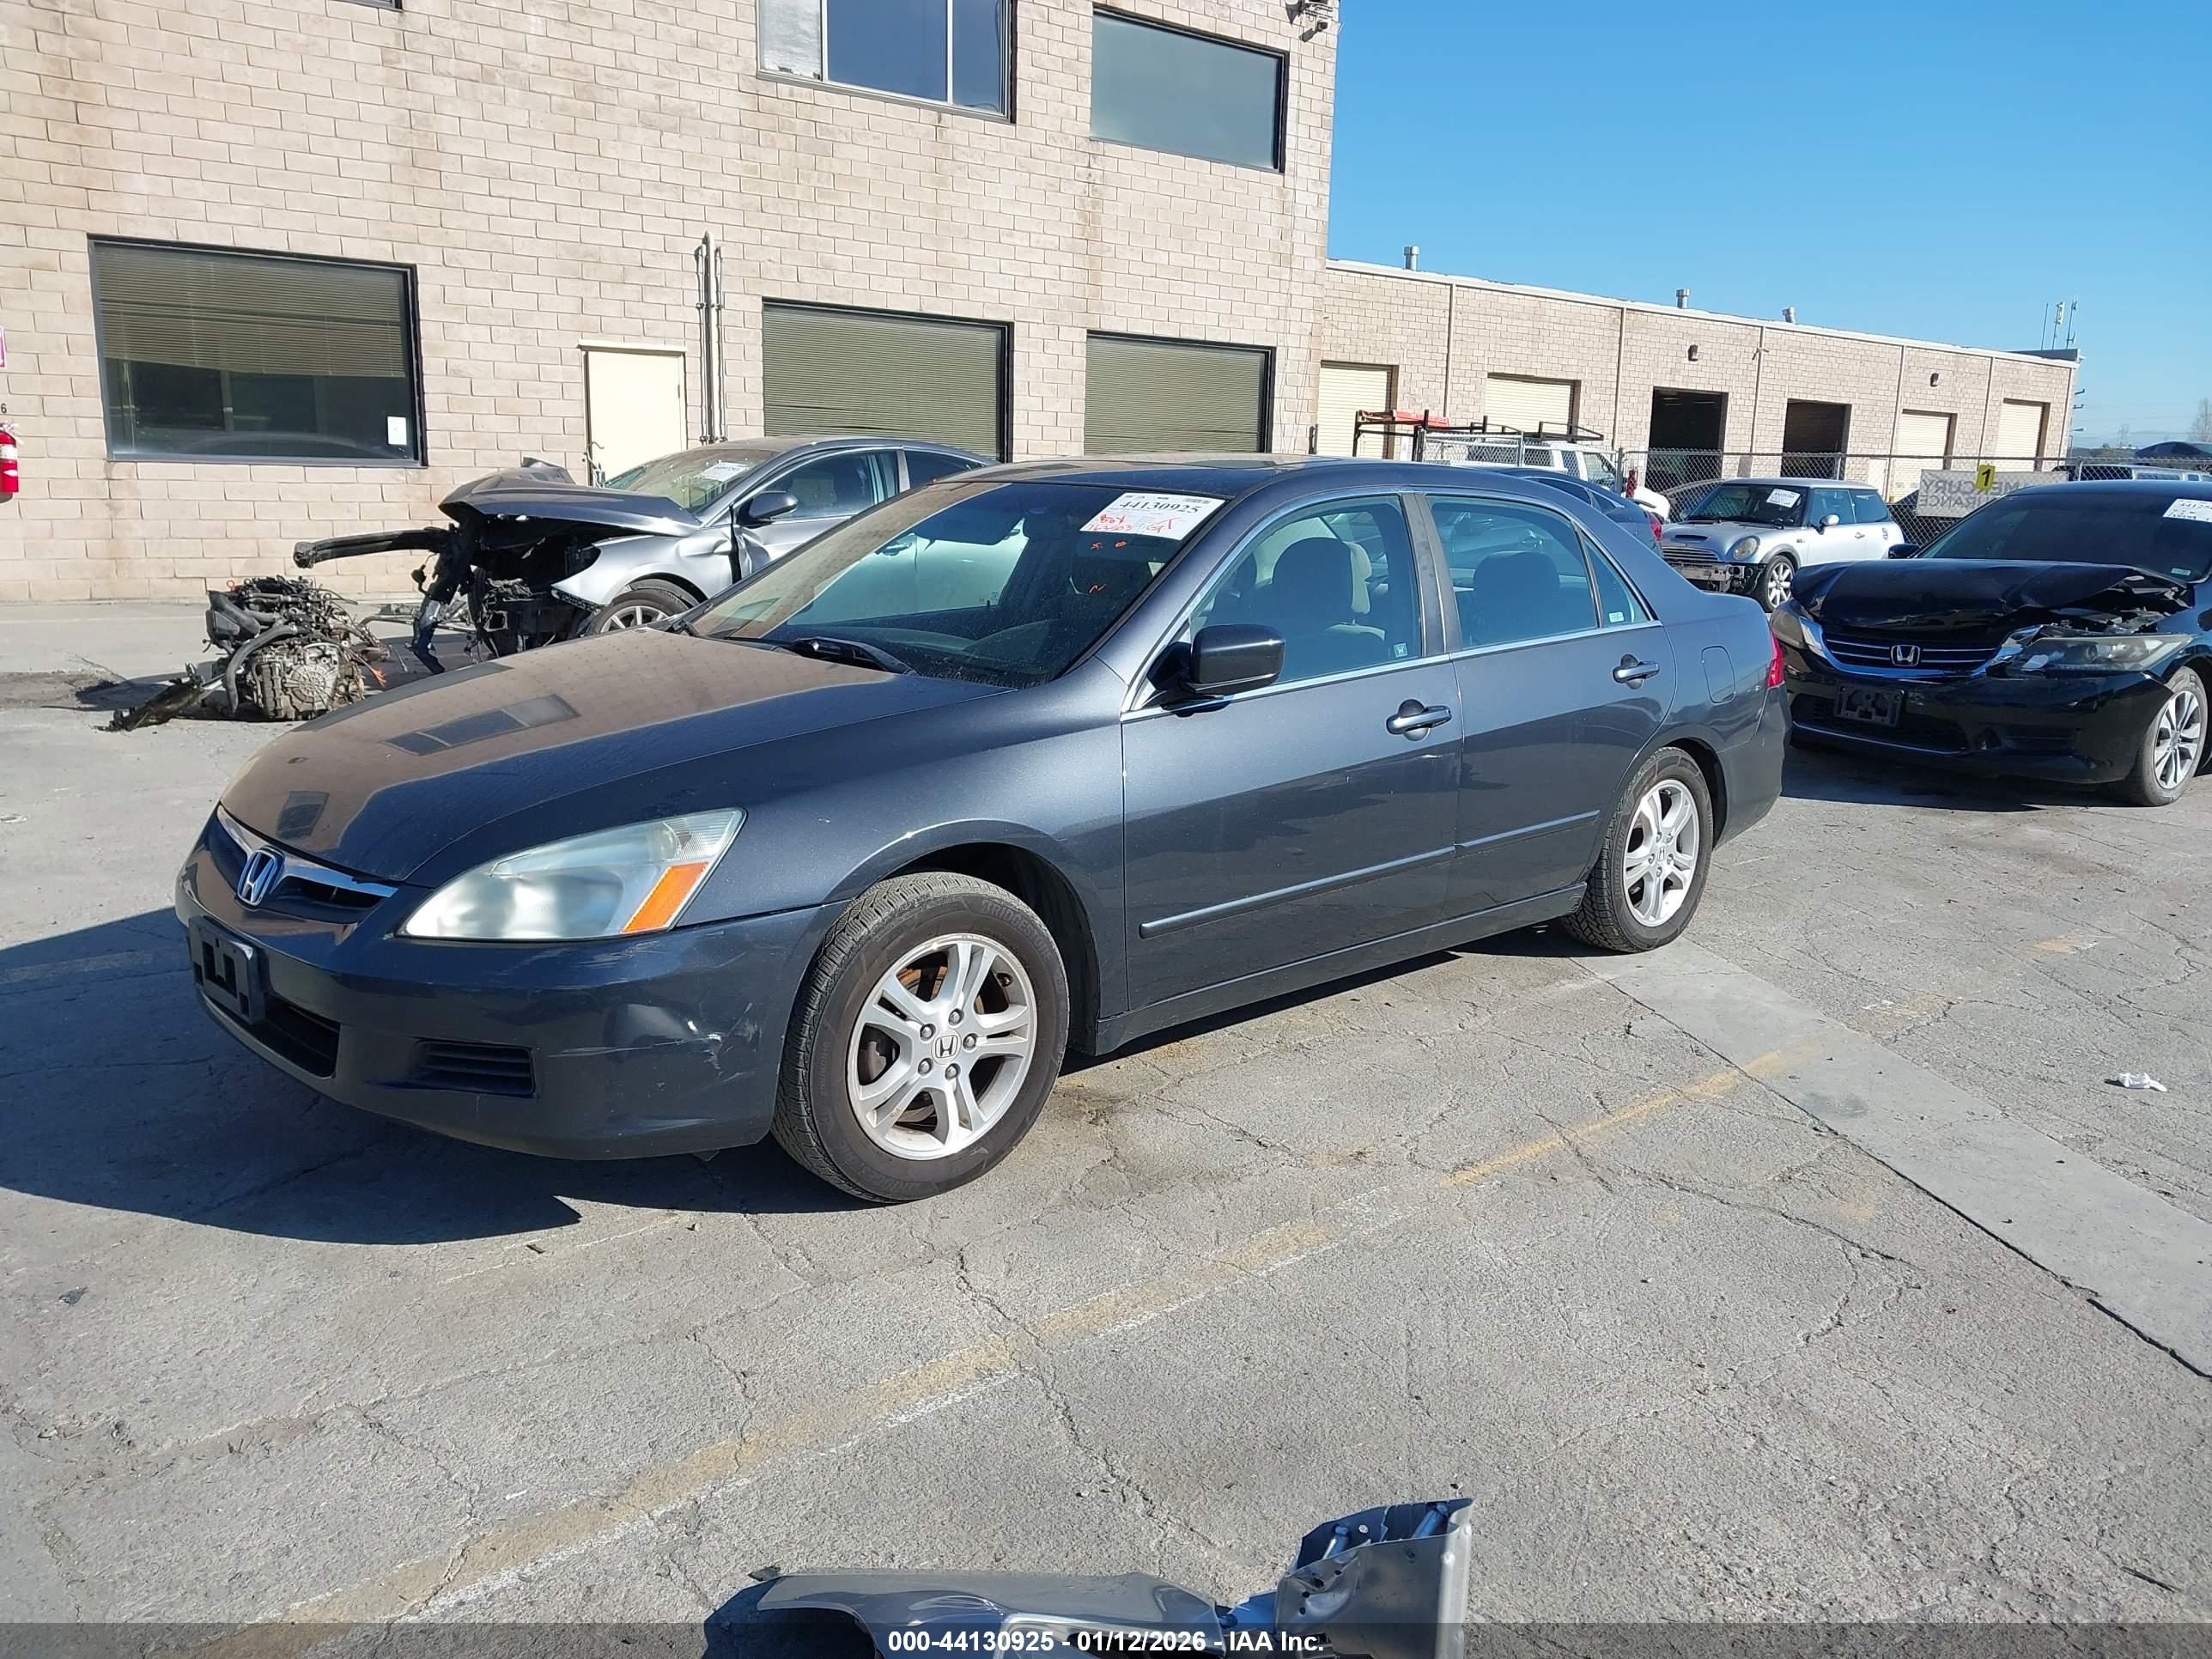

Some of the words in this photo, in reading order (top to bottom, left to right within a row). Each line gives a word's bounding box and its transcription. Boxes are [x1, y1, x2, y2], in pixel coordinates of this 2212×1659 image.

[0, 402, 8, 414] 6
[1981, 468, 1991, 487] 1
[1120, 501, 1202, 514] 44130925
